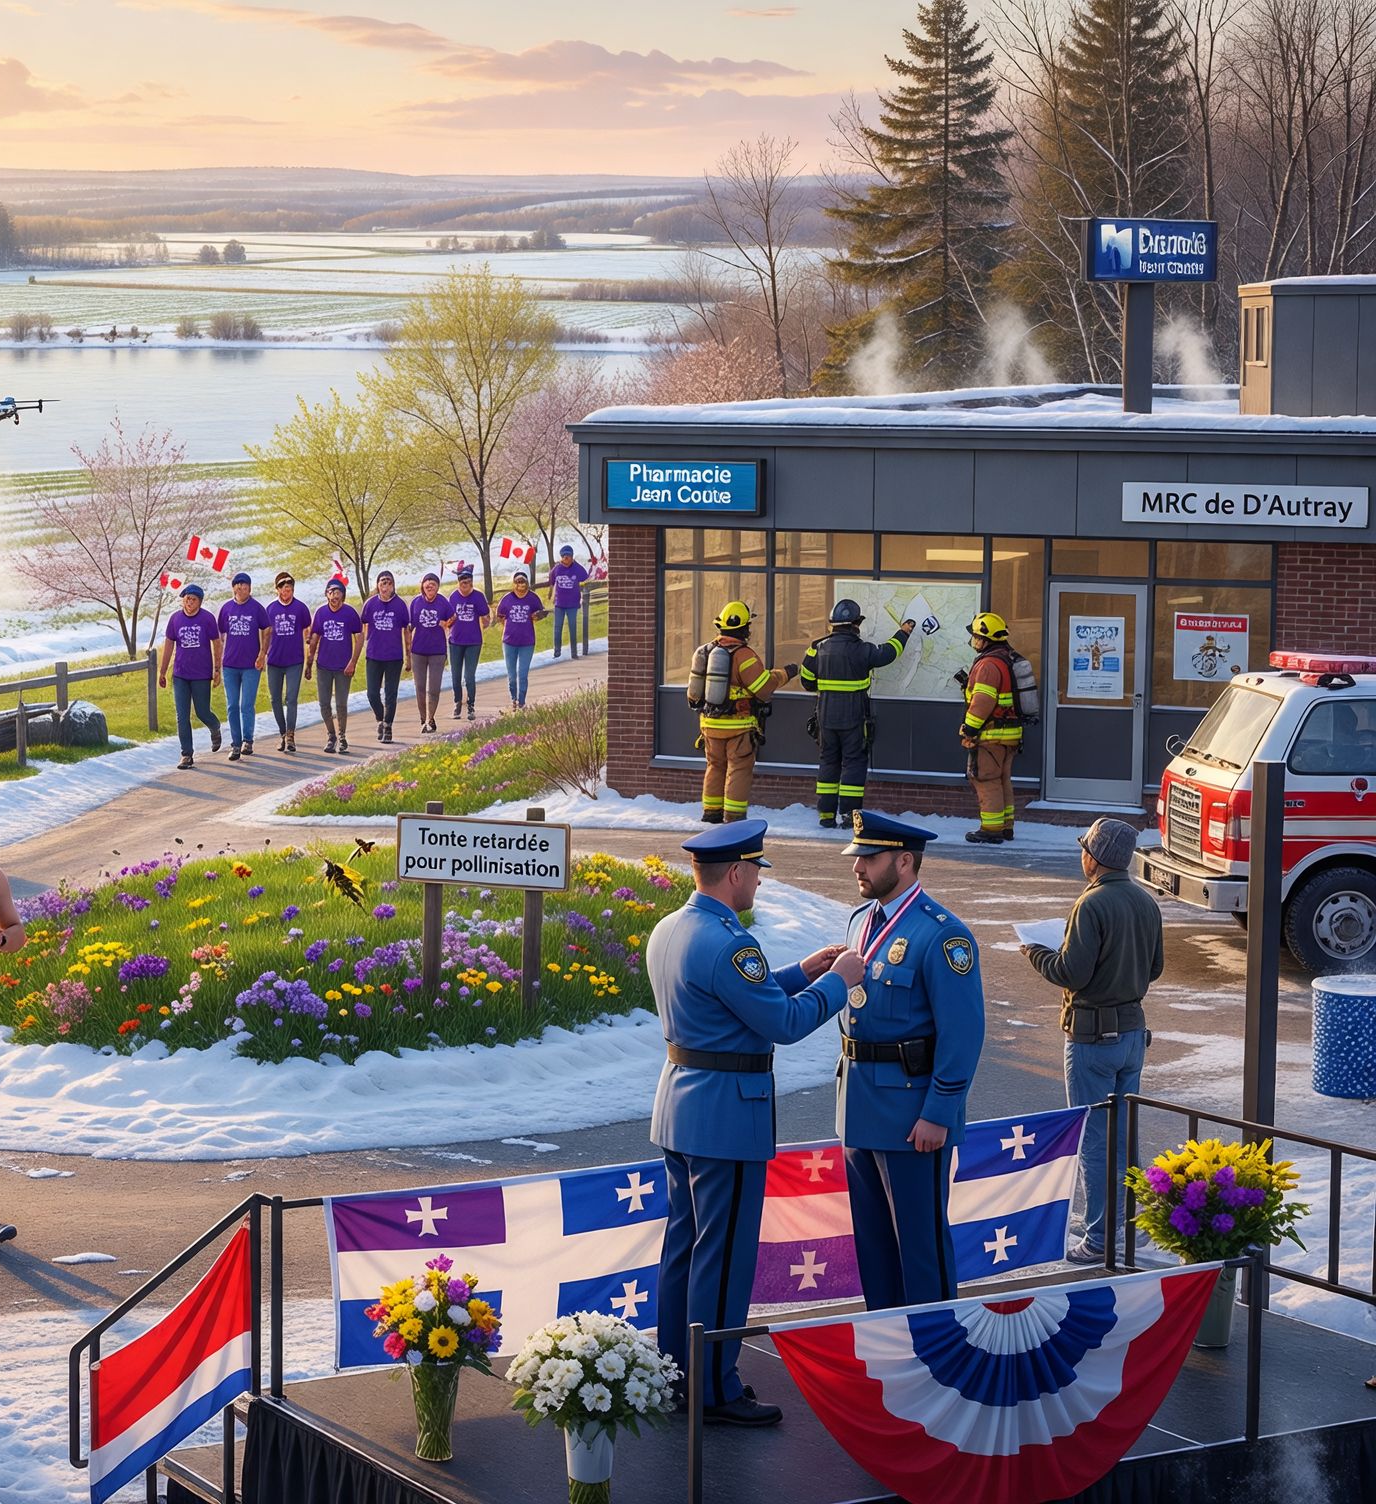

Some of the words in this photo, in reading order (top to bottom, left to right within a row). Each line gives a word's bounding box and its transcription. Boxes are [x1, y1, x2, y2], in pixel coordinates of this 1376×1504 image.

[1141, 491, 1197, 515] MRC
[1204, 492, 1235, 515] de
[1243, 493, 1353, 523] D'Autray
[418, 827, 468, 848] Tonte
[473, 833, 550, 853] retardée
[404, 855, 447, 877] pour
[451, 855, 560, 878] pollinisation
